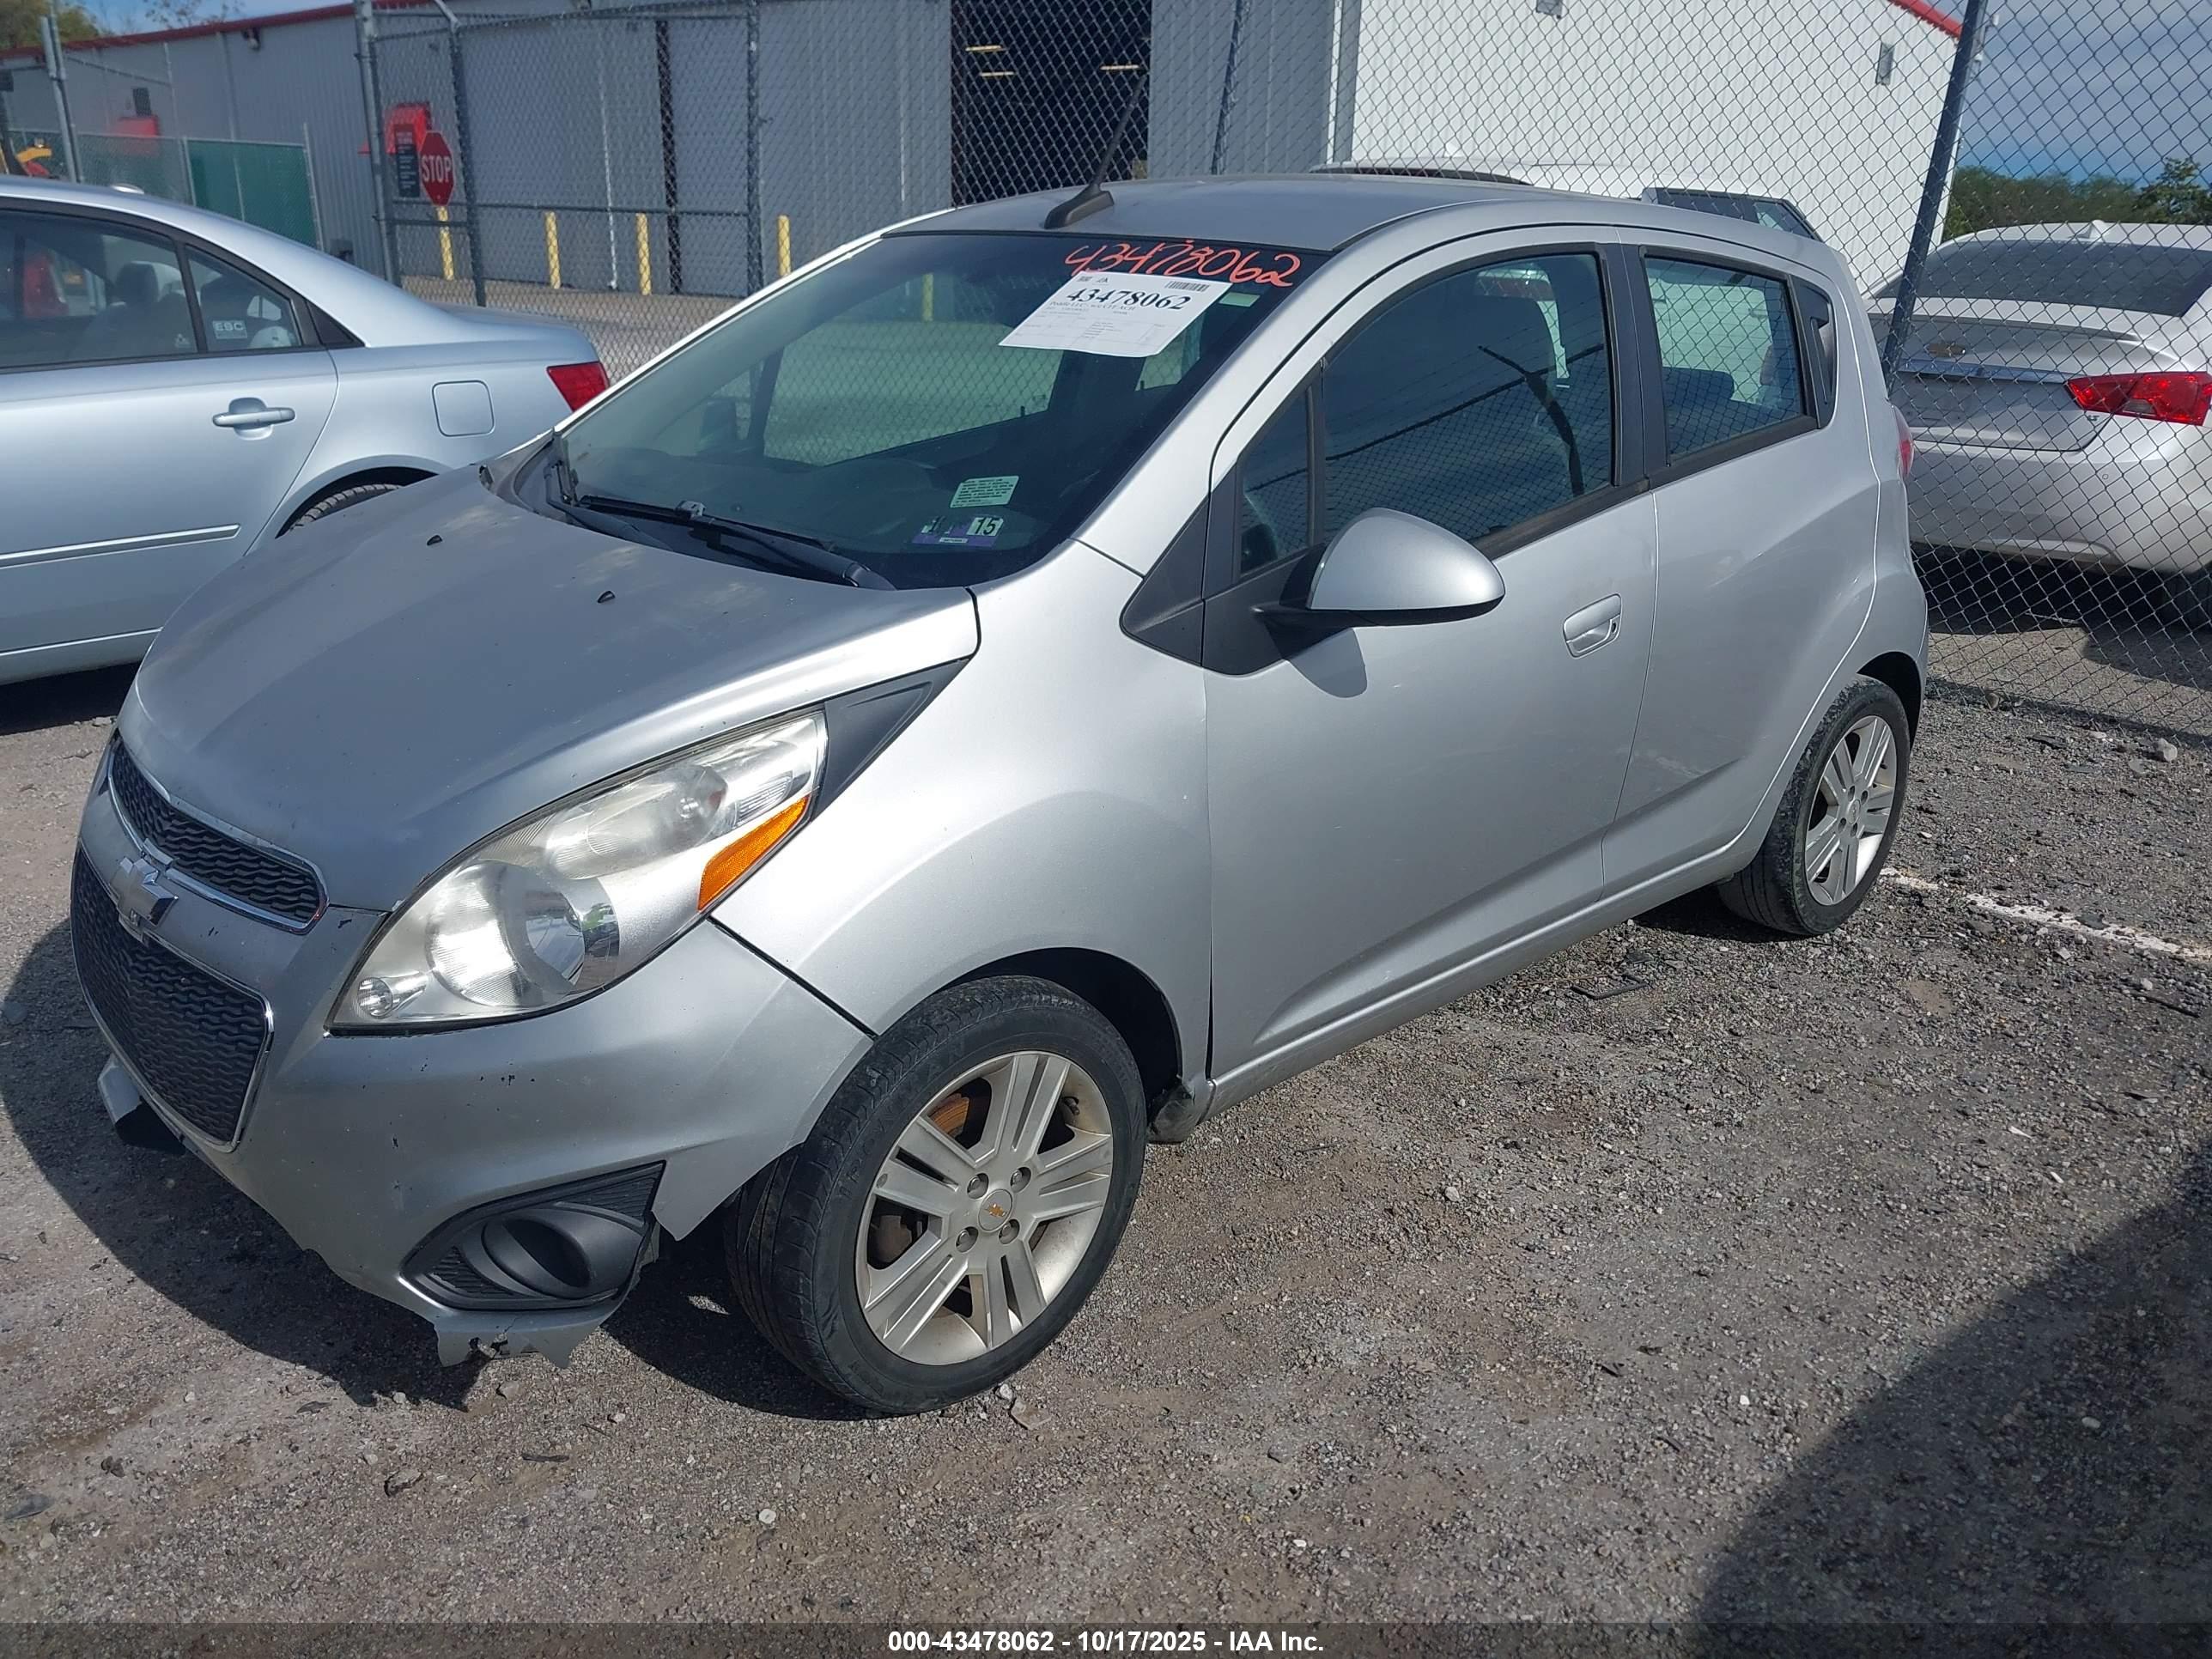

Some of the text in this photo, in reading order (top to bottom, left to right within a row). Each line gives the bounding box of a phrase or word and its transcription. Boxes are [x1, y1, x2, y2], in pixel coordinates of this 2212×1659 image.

[421, 155, 453, 183] STOP
[1064, 240, 1301, 288] 43478062
[1066, 288, 1192, 310] 43478062
[214, 321, 245, 331] ESC
[975, 517, 1000, 535] 15
